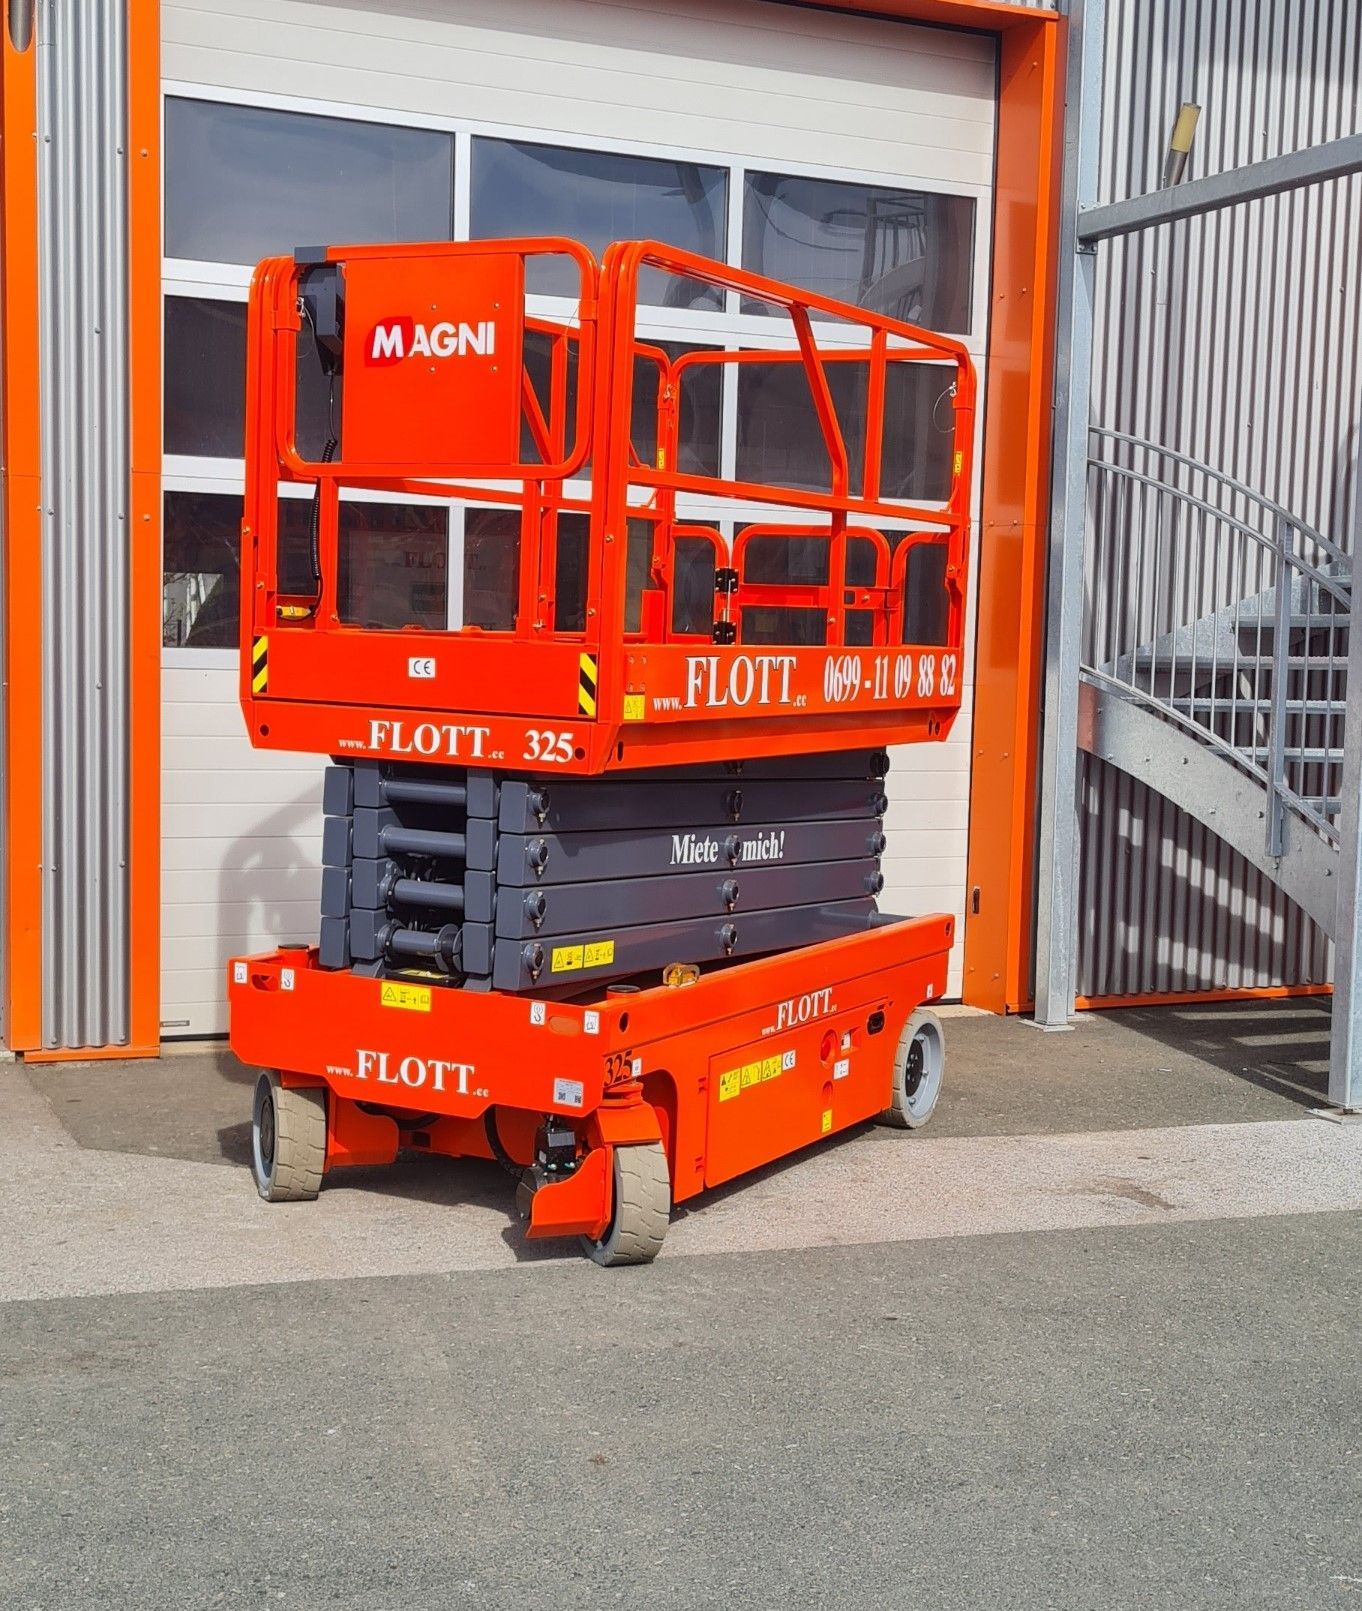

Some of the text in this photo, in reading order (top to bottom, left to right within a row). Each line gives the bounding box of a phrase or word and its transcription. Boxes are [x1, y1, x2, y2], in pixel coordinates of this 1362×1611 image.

[372, 321, 495, 358] MAGNI
[894, 654, 912, 699] 09
[917, 654, 935, 698] 88
[940, 653, 957, 696] 82
[522, 729, 574, 763] 325
[669, 830, 785, 864] Miete mich!
[603, 1049, 633, 1087] 325
